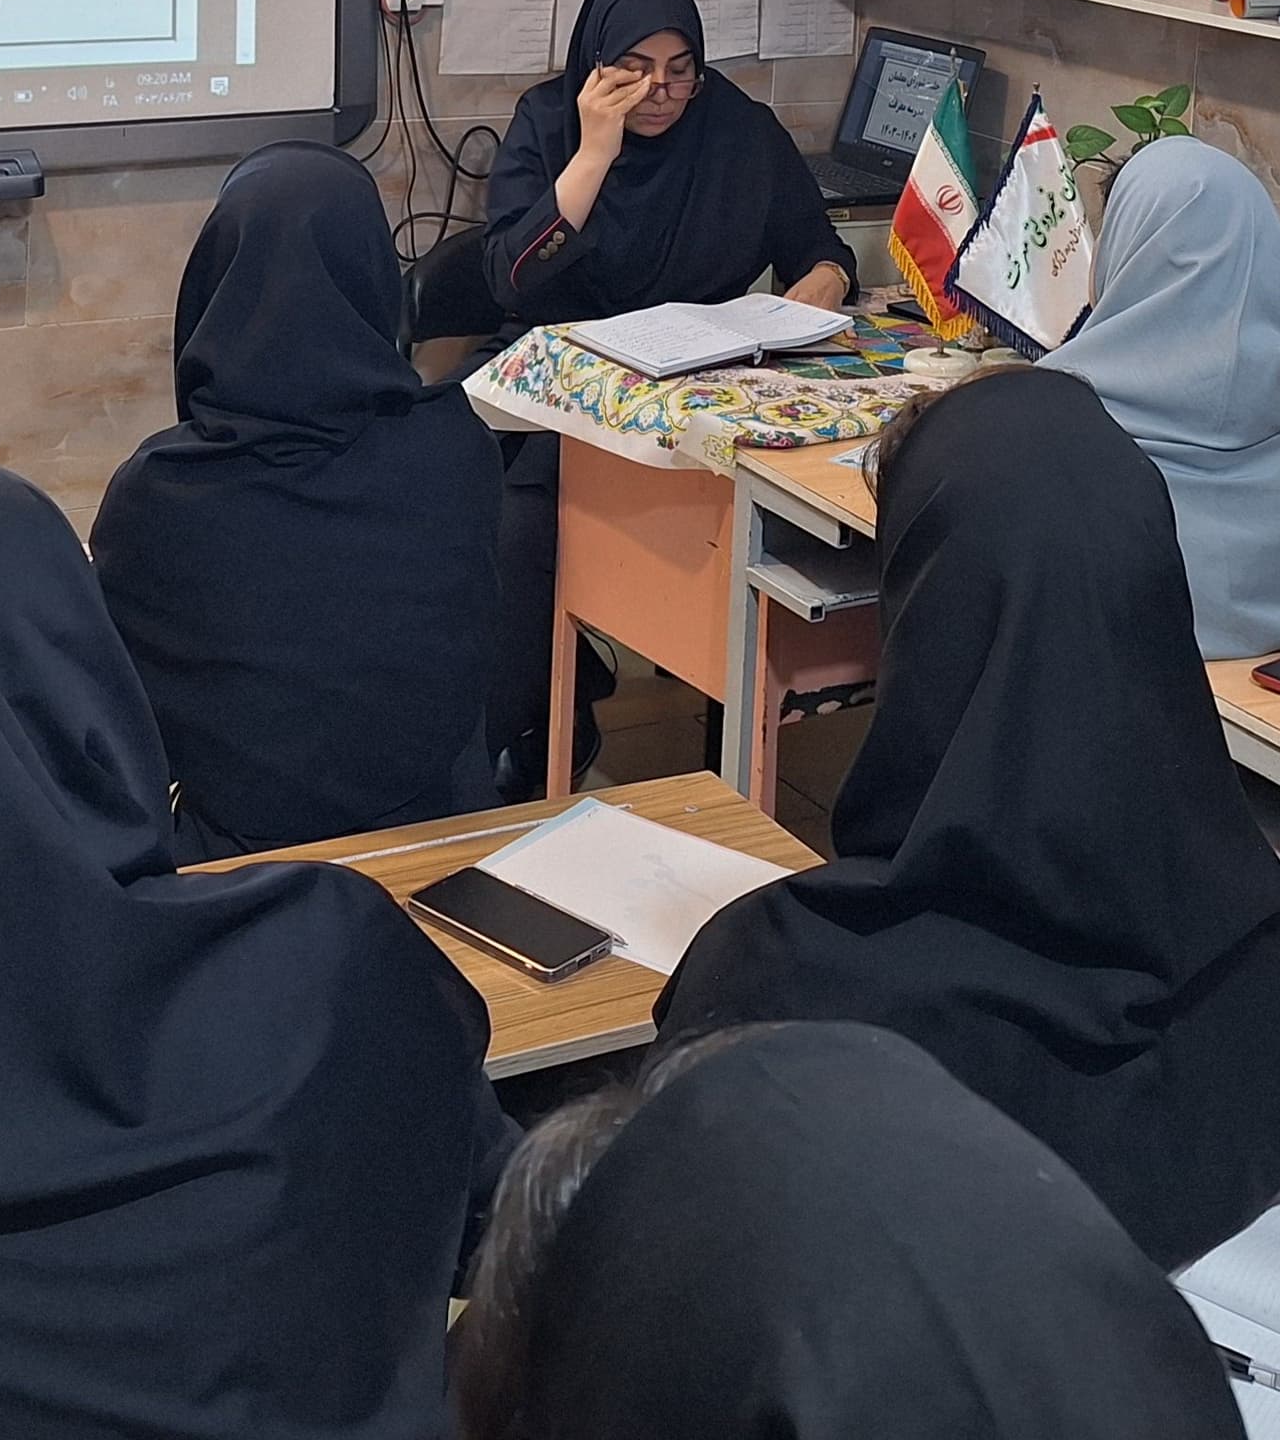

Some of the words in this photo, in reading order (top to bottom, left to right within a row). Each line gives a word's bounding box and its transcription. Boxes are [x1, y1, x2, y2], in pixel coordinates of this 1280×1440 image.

[137, 73, 168, 86] 09:20
[170, 72, 191, 84] AM
[103, 95, 119, 107] FA
